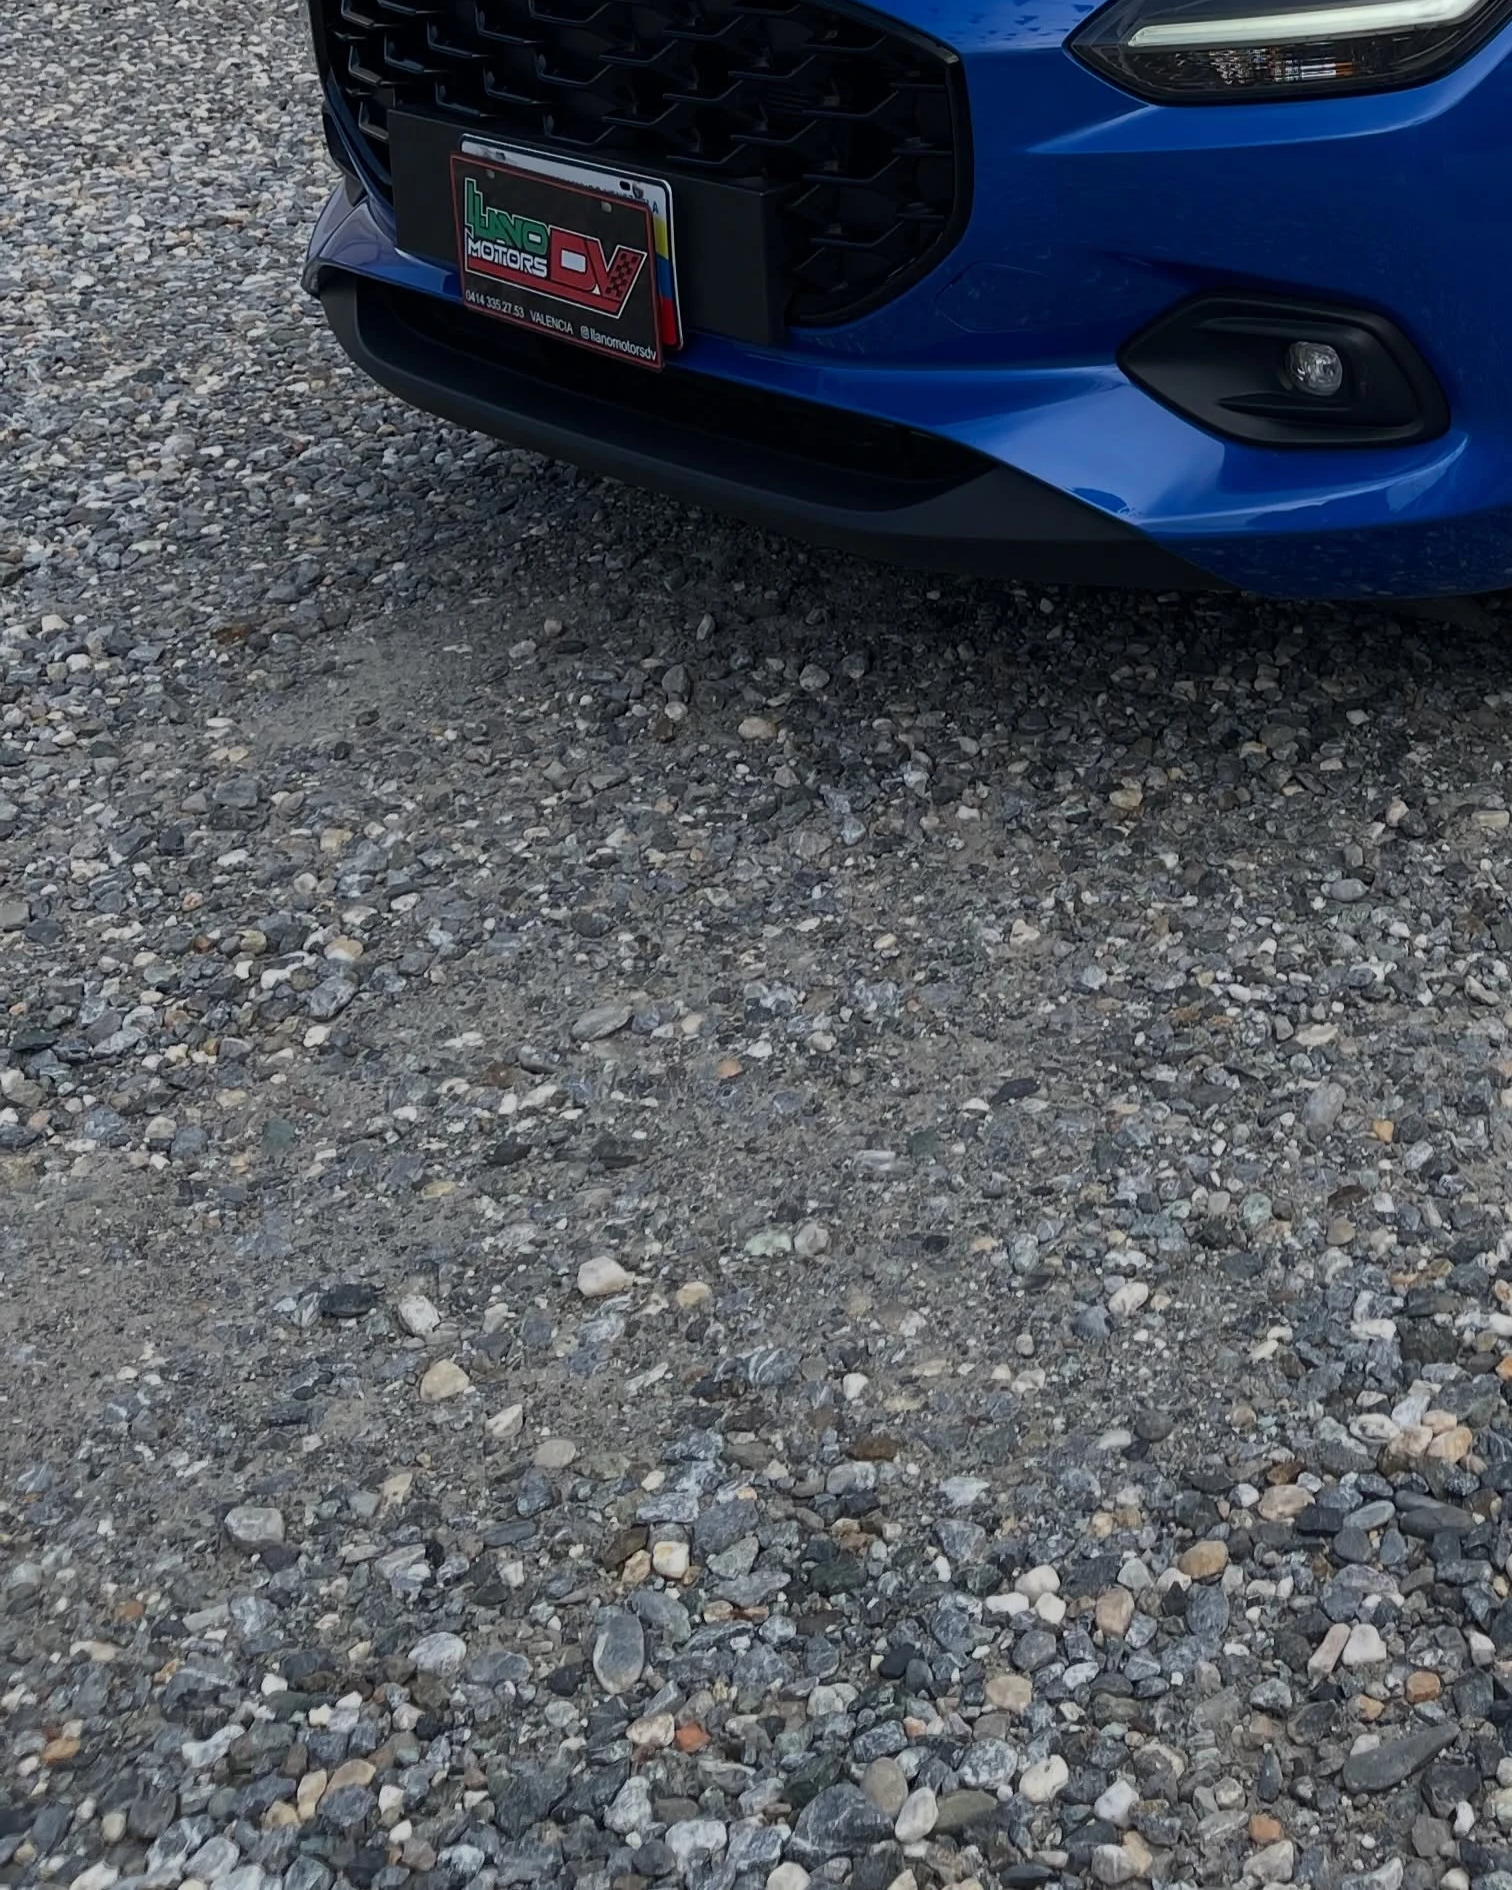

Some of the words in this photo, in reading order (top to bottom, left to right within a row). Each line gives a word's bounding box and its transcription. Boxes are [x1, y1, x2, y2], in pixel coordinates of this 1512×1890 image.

[465, 179, 549, 255] LLANO
[468, 237, 548, 278] MOTORS
[550, 226, 646, 300] DV
[465, 289, 485, 306] 0414
[529, 310, 575, 335] VALENCIA
[580, 325, 658, 361] @llanomotorsdv
